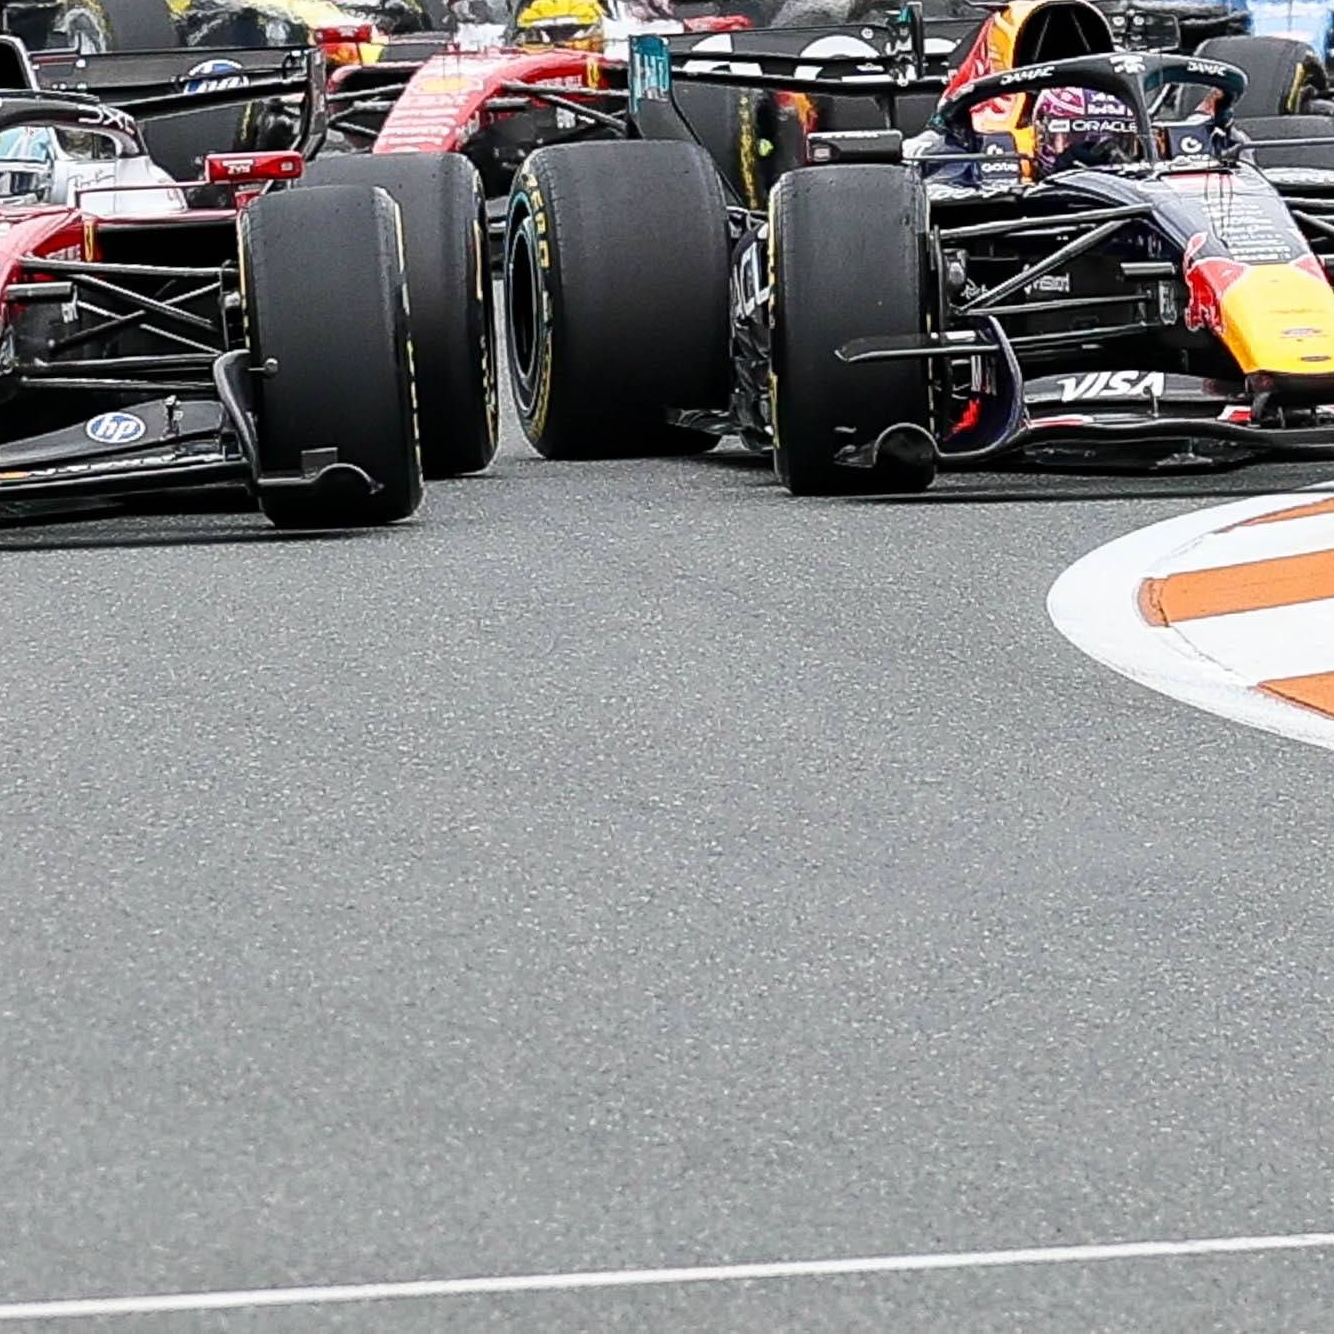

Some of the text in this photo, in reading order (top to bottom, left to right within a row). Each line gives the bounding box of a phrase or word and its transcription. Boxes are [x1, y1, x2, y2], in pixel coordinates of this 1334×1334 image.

[1071, 119, 1138, 134] ORACLE
[1057, 371, 1165, 402] VISA
[96, 413, 138, 442] hp
